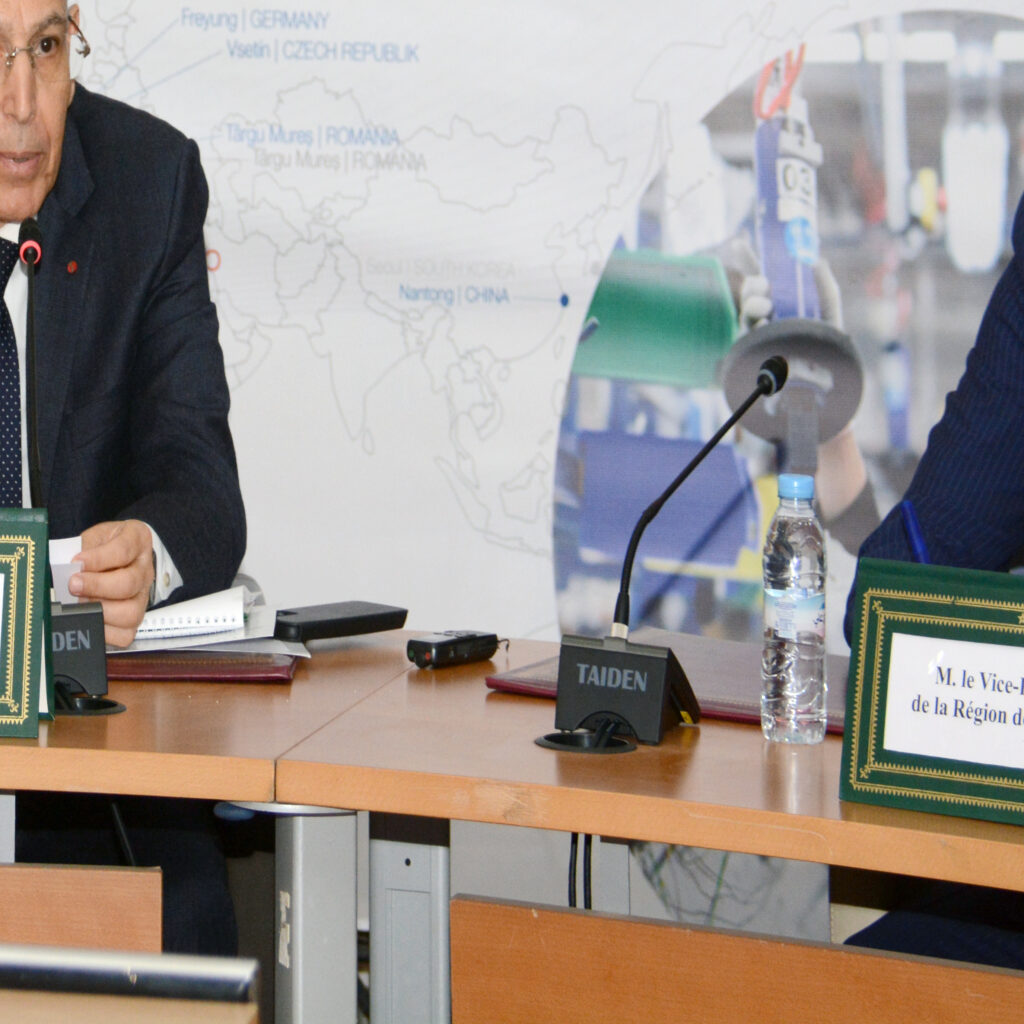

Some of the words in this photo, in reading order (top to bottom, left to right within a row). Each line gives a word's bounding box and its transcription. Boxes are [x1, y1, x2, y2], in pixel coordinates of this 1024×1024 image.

[180, 7, 238, 32] Freyung
[249, 9, 330, 31] GERMANY
[282, 39, 338, 61] CZECH
[341, 41, 420, 63] REPUBLIK
[398, 283, 455, 307] Nantong
[464, 284, 510, 304] CHINA
[576, 662, 648, 693] TAIDEN
[935, 666, 956, 687] M.
[961, 669, 975, 689] le
[911, 694, 930, 714] de
[934, 696, 948, 716] la
[953, 698, 1008, 726] Région
